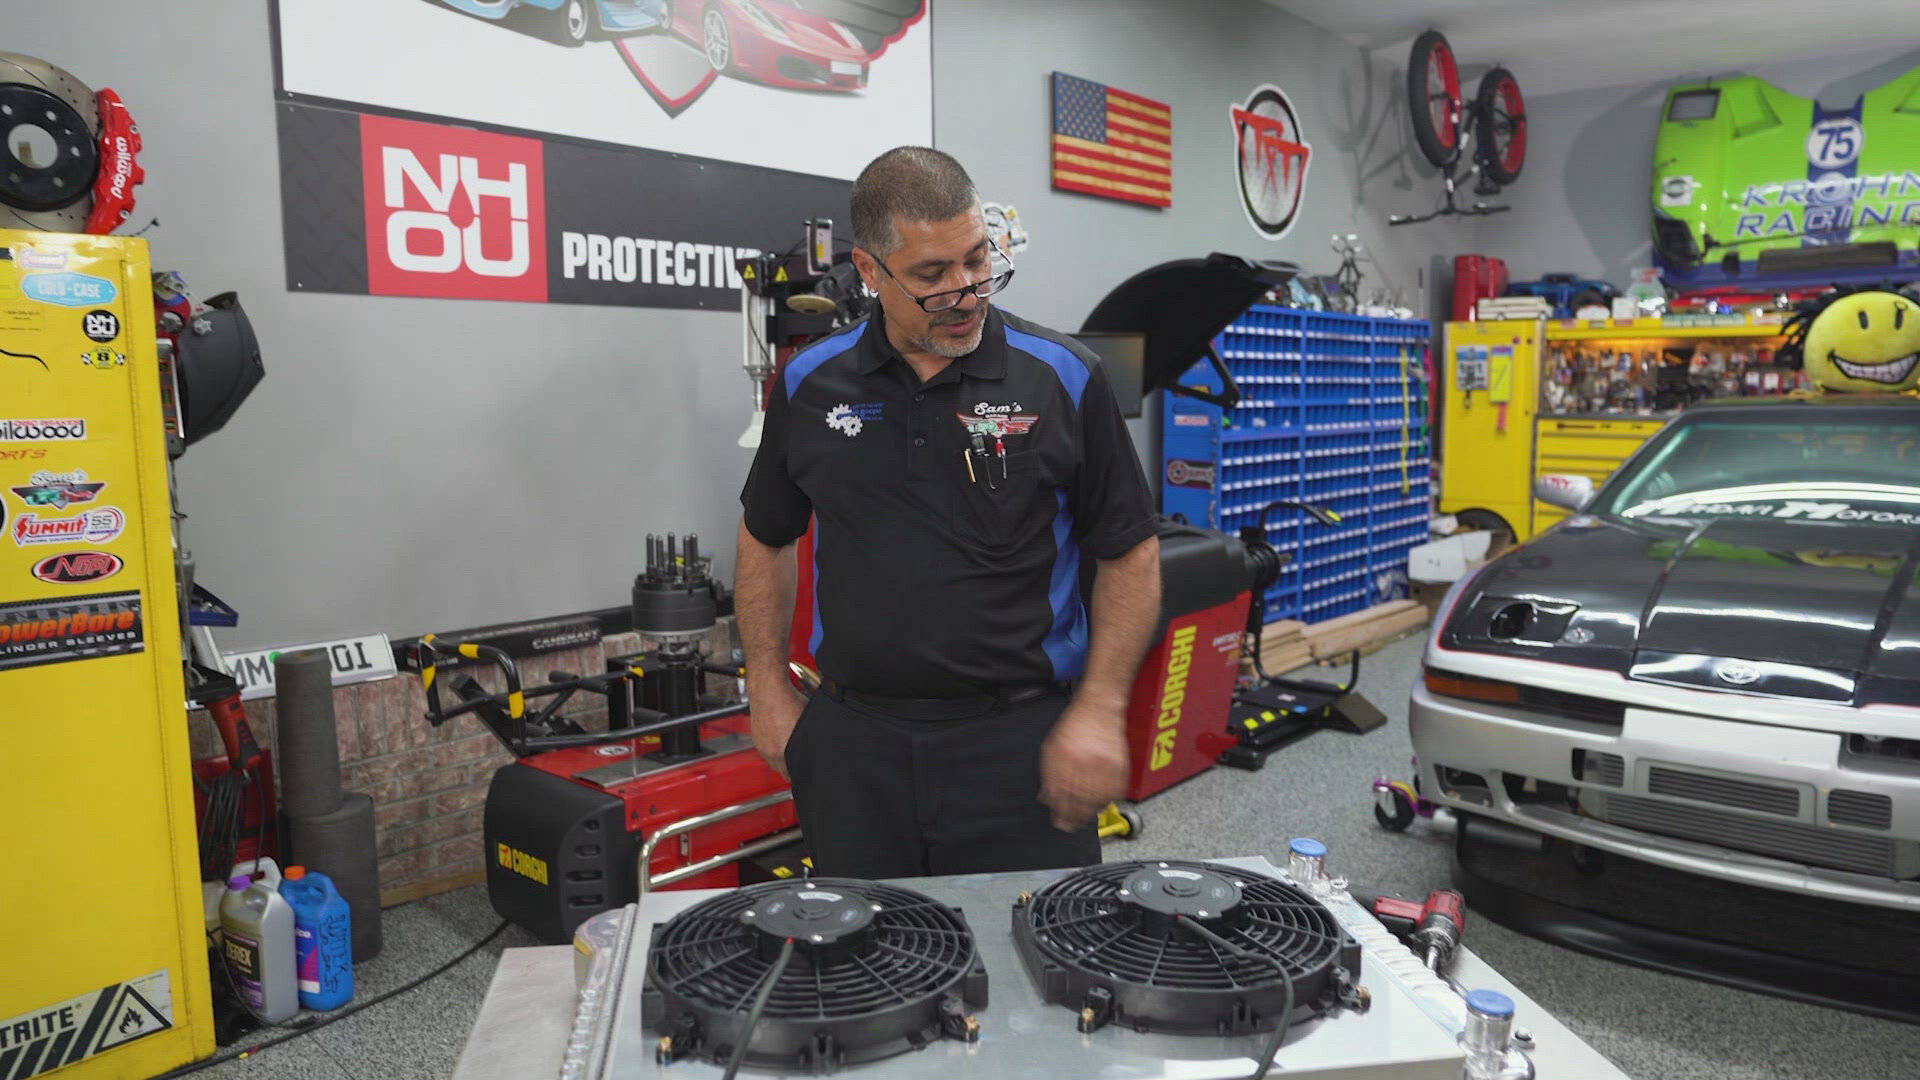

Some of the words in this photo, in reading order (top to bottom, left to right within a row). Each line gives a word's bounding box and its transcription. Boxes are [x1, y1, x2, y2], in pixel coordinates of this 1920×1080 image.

[1817, 125, 1854, 161] 75
[562, 231, 761, 290] PROTECTIV
[974, 402, 1022, 415] Sam's
[0, 419, 84, 439] ilwood
[66, 631, 136, 646] SLEEVES
[1157, 625, 1197, 730] CORGHI
[512, 848, 549, 886] CORGHI
